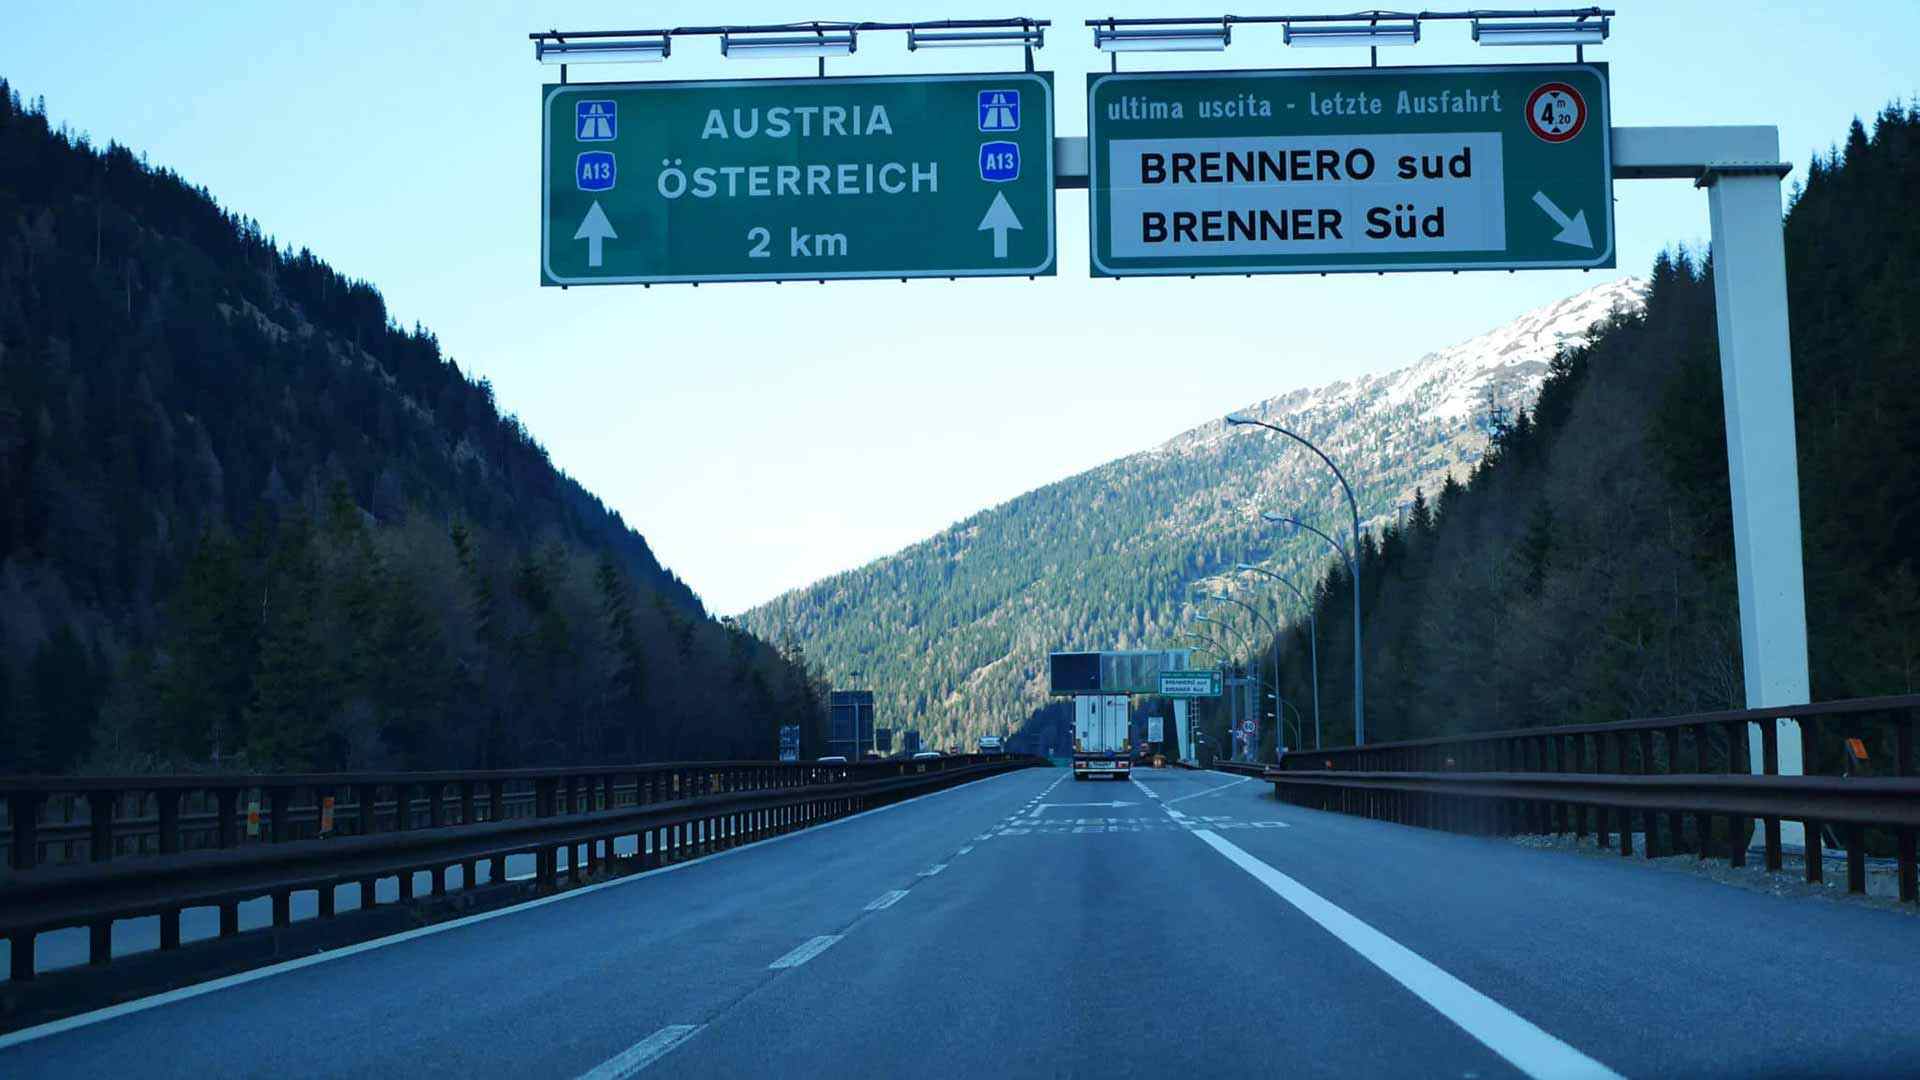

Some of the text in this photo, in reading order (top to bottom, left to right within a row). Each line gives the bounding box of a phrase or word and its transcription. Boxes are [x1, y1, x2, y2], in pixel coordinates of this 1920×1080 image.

[1108, 96, 1184, 121] ultima
[1199, 93, 1272, 118] uscita
[1310, 91, 1382, 116] letzte
[1397, 88, 1503, 115] Ausfahrt
[701, 105, 893, 140] AUSTRIA
[582, 163, 611, 181] A13
[986, 152, 1015, 171] A13
[1141, 147, 1472, 185] BRENNERO sud
[657, 159, 938, 199] ÖSTERREICH
[1142, 204, 1445, 243] BRENNER Süd
[747, 226, 848, 258] 2 km
